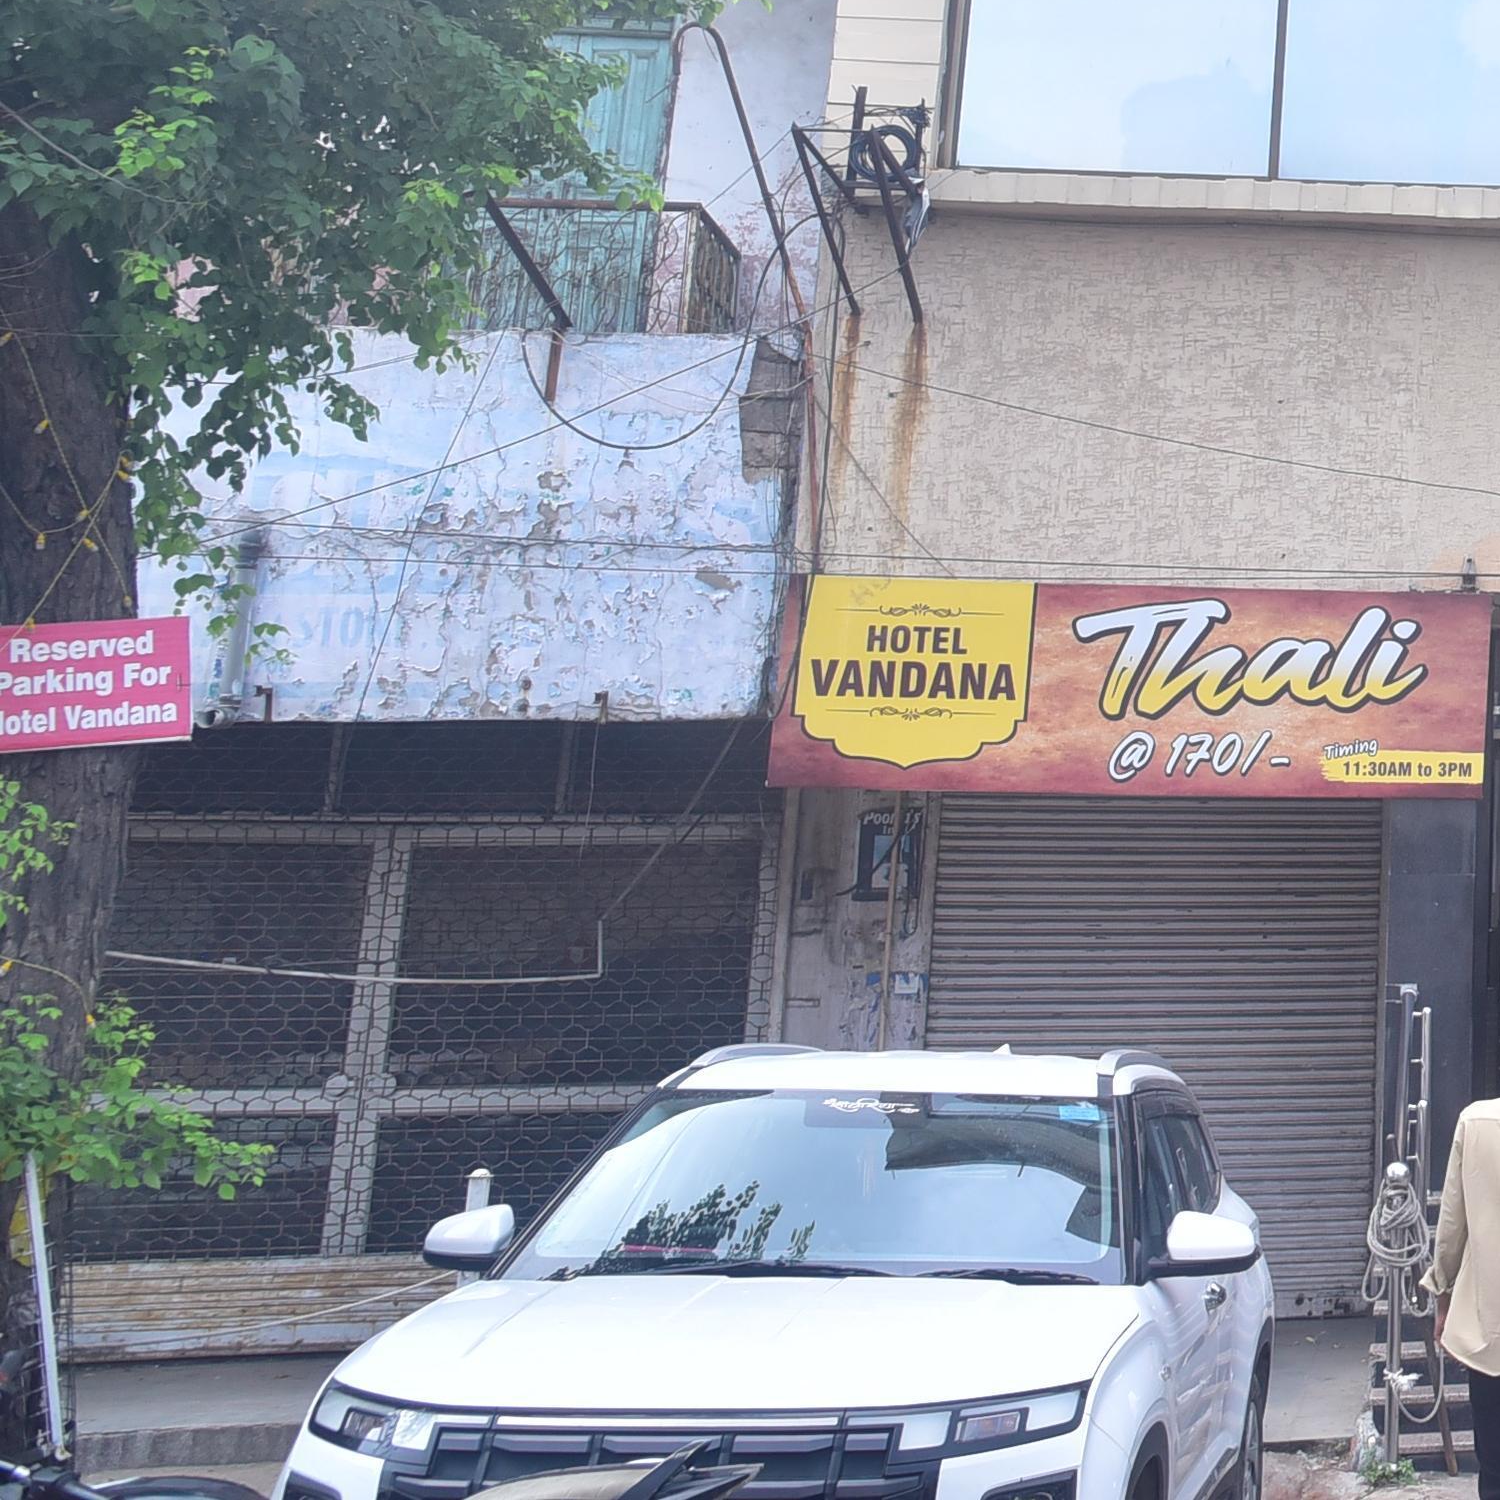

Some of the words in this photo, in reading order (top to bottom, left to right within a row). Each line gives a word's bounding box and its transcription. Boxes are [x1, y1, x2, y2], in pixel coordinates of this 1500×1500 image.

[10, 630, 154, 663] Reserved
[866, 625, 967, 655] HOTEL
[1072, 598, 1428, 721] Thali
[0, 667, 113, 696] Parking
[124, 663, 171, 688] For
[811, 659, 1017, 702] VANDANA
[0, 705, 56, 736] otel
[64, 701, 177, 731] Vandana
[1109, 729, 1156, 783] @
[1165, 729, 1291, 779] 170/-
[1323, 739, 1378, 759] Timing
[1343, 761, 1412, 777] 11:30AM
[1417, 762, 1432, 777] to
[1438, 762, 1472, 777] 3PM
